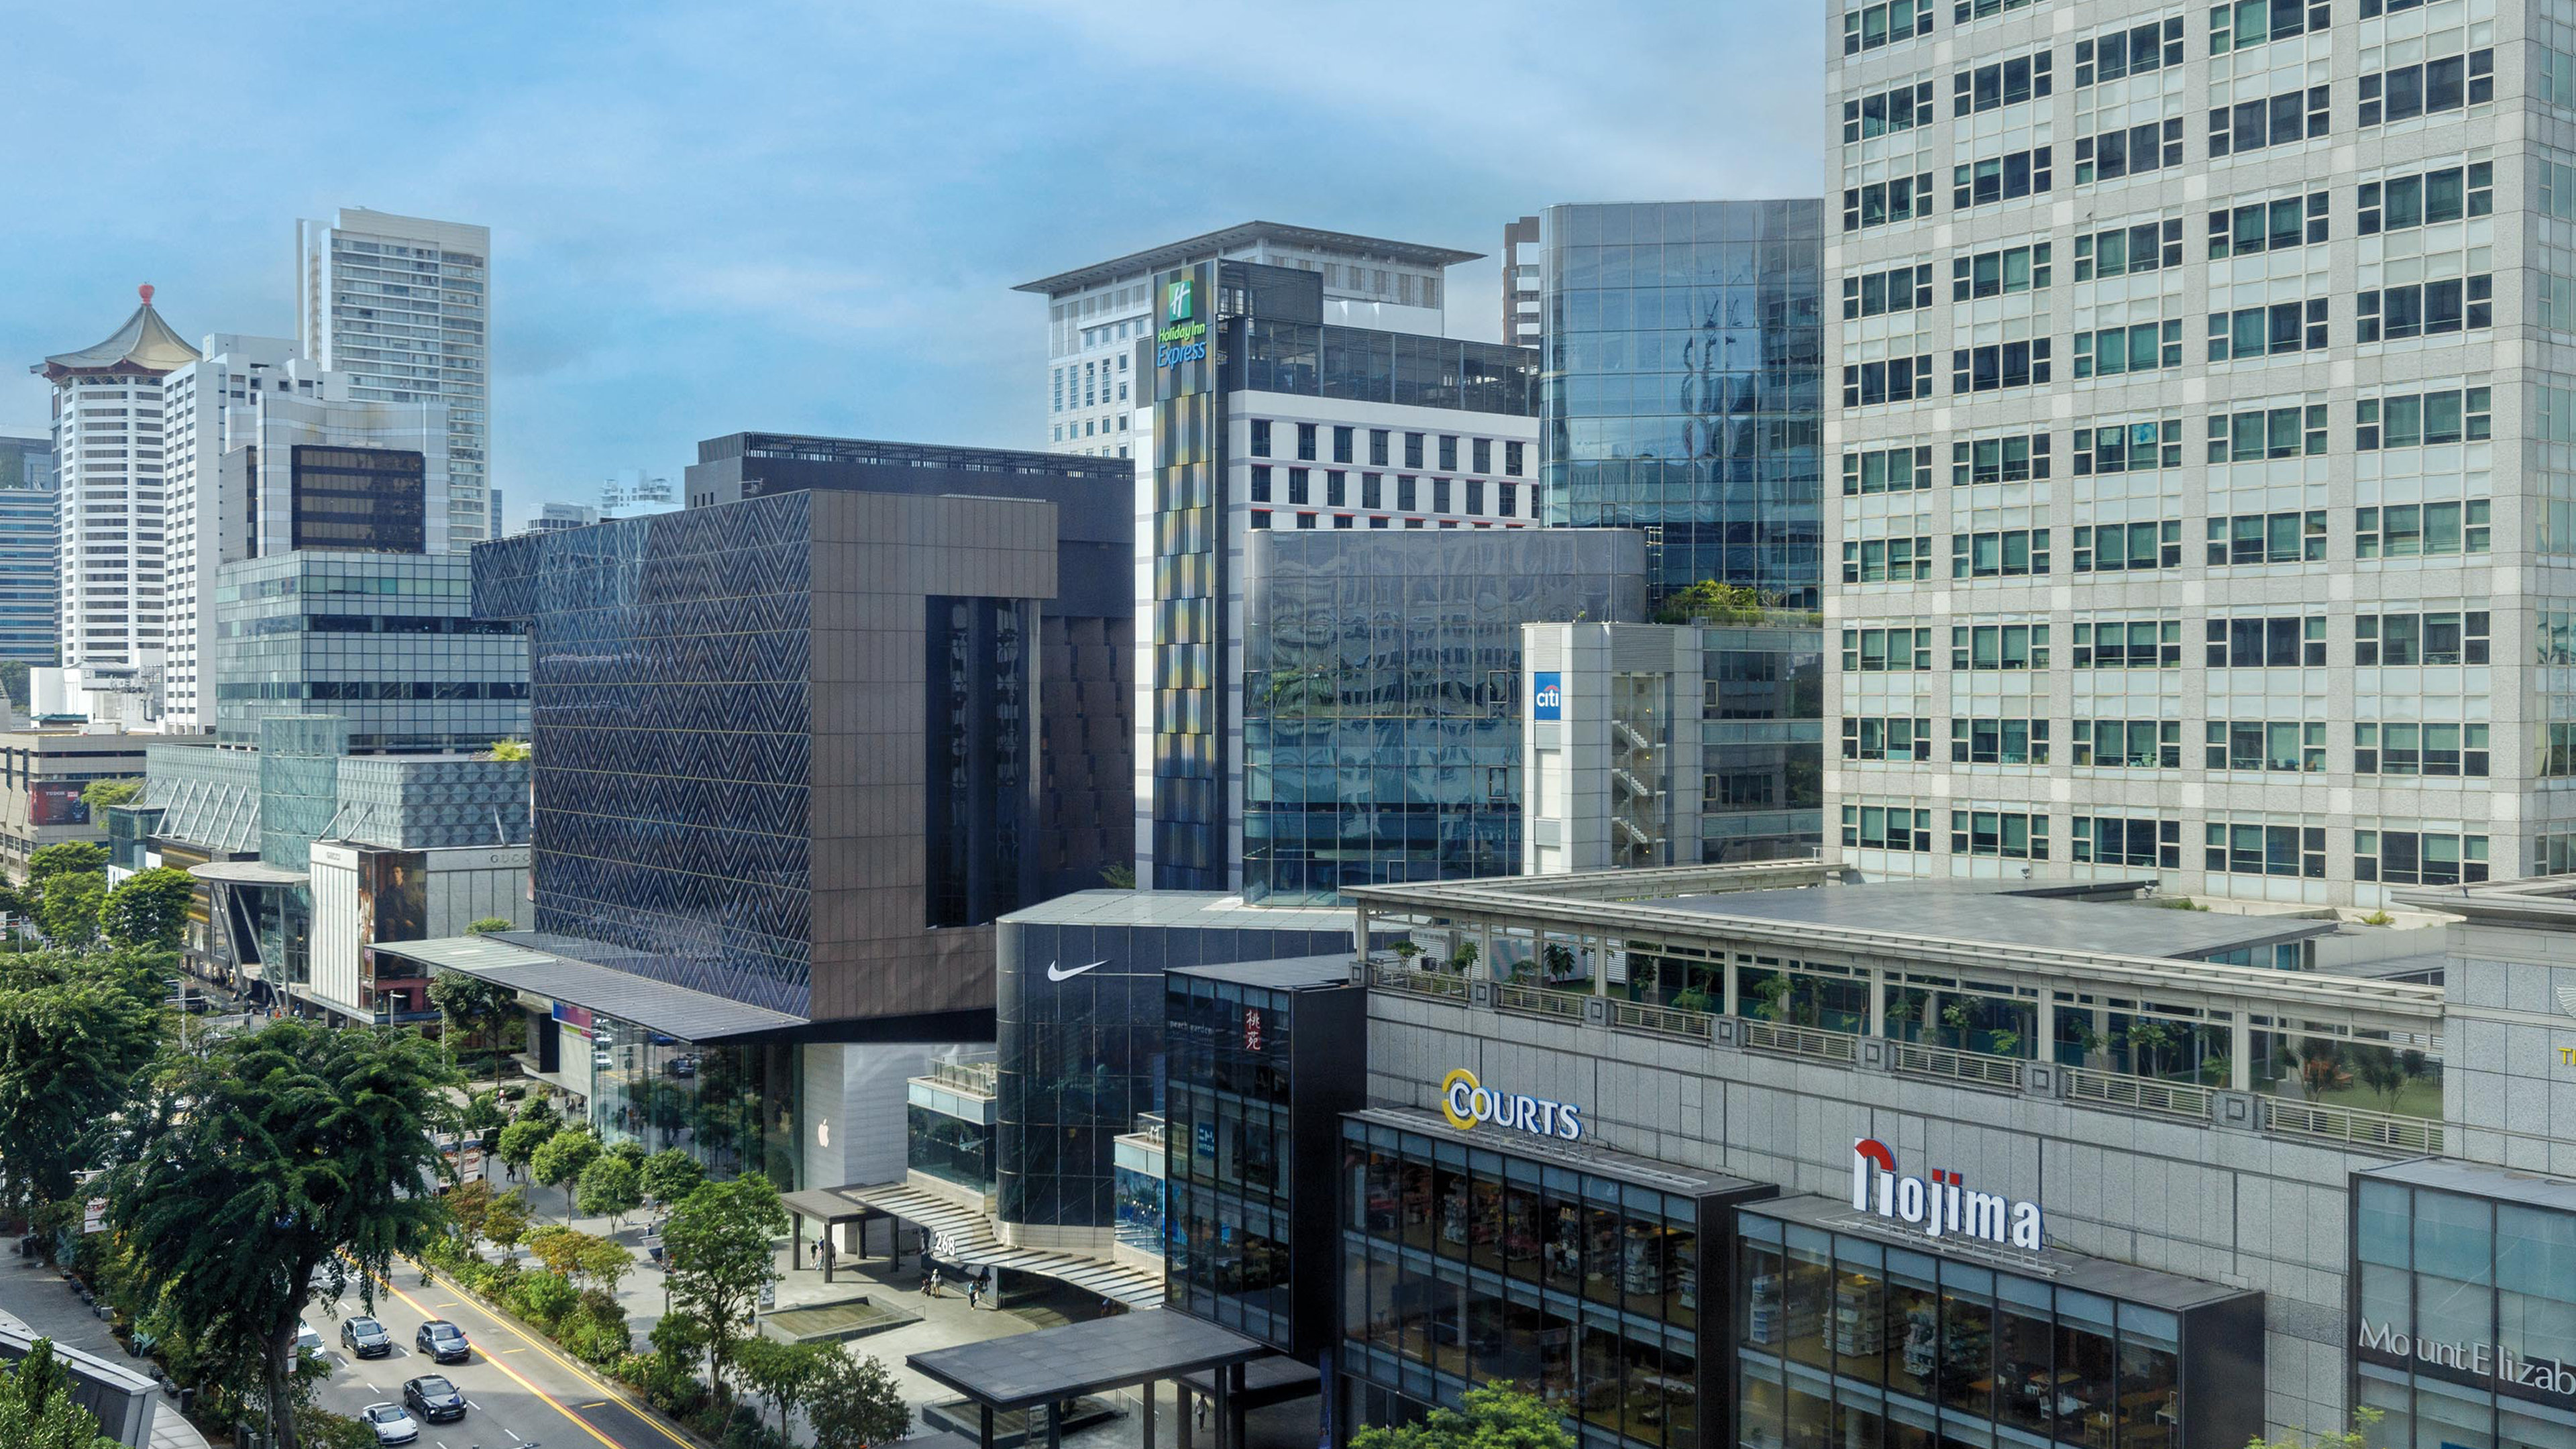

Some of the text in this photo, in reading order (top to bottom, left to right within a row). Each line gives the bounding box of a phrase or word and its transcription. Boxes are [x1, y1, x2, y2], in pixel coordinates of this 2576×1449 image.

[1158, 320, 1205, 343] Holiday Inn
[1157, 341, 1207, 370] Express
[1536, 687, 1559, 707] citi
[1246, 1009, 1260, 1051] 桃苑
[1446, 1077, 1582, 1140] COURTS
[935, 1232, 956, 1256] 268
[2358, 1317, 2467, 1371] Mount
